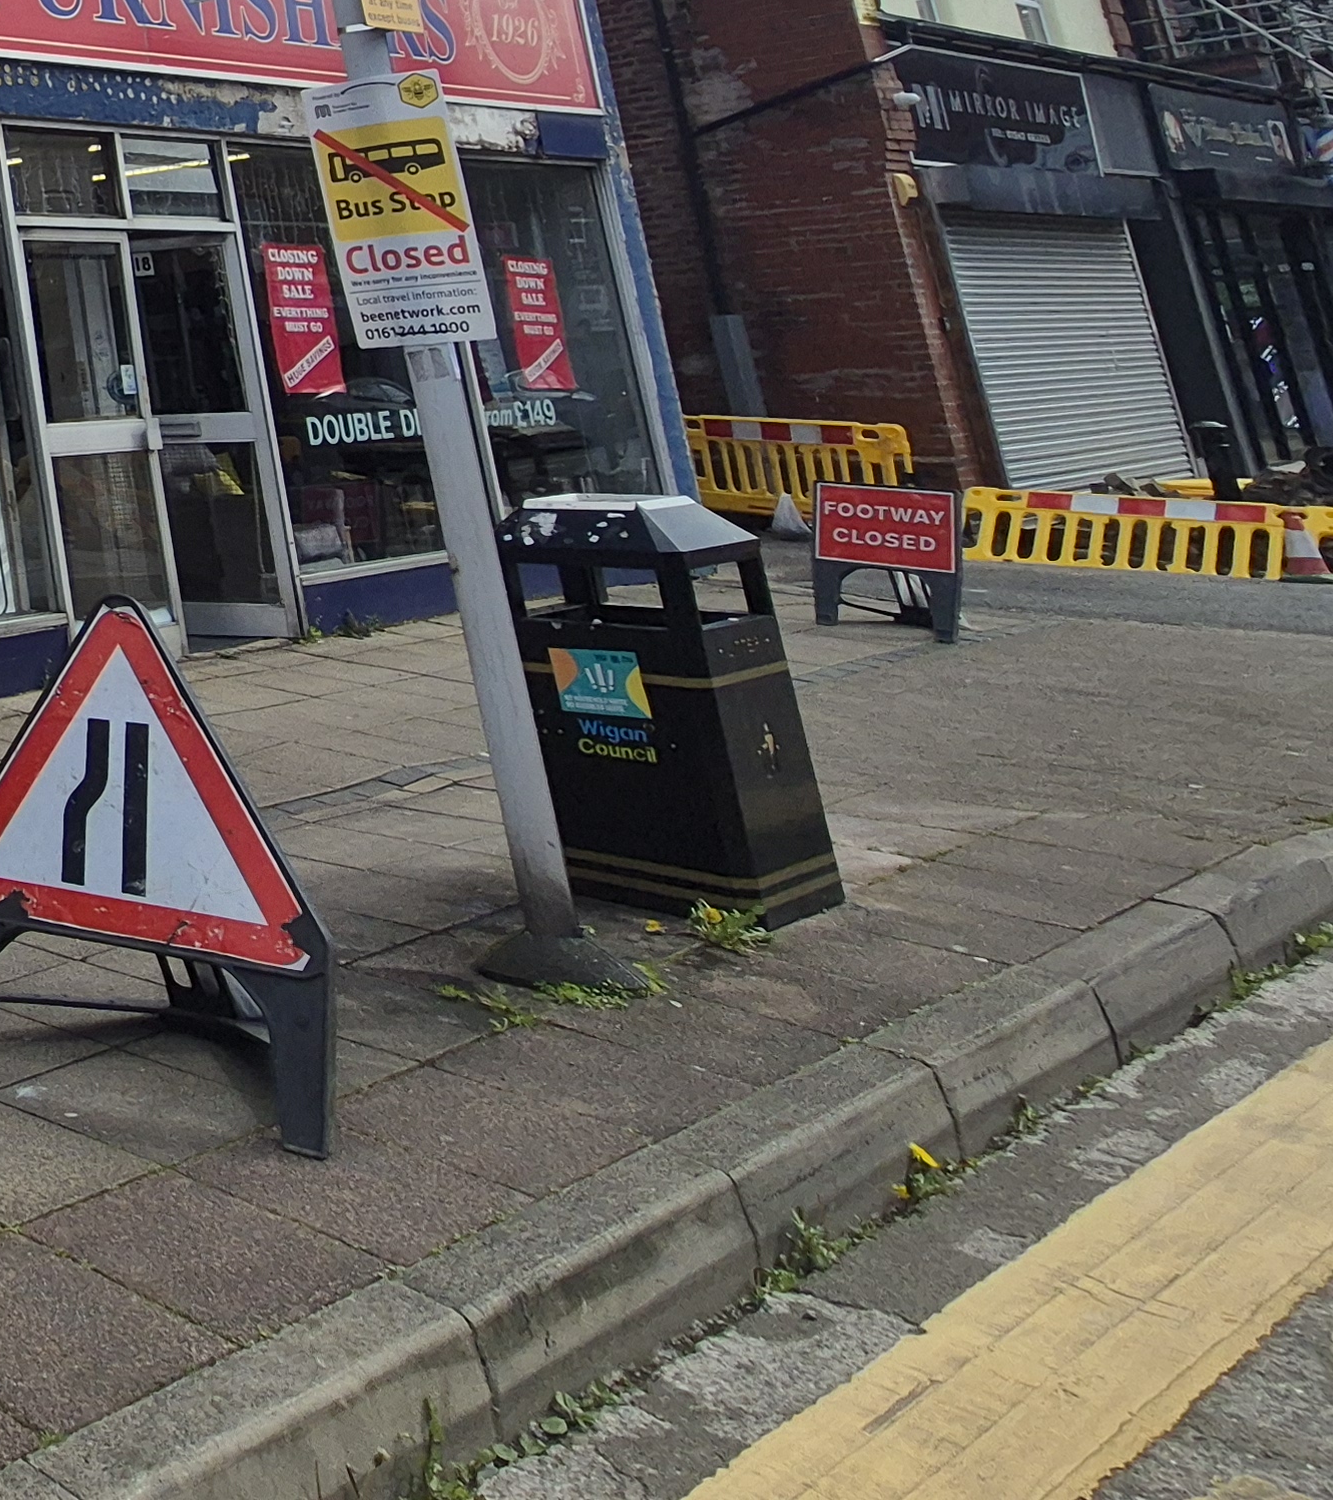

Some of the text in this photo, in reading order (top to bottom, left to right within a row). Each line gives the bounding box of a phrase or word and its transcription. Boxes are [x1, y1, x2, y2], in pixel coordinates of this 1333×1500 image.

[491, 14, 539, 46] 1926
[948, 89, 1081, 129] MIRROR IMAGE
[335, 199, 384, 220] Bus
[135, 256, 151, 271] 18
[268, 248, 318, 263] CLOSING
[345, 234, 470, 275] Closed
[277, 267, 313, 281] DOWN
[507, 260, 548, 275] CLOSING
[282, 285, 314, 299] SALE
[356, 294, 381, 306] Local
[382, 292, 411, 303] travel
[360, 304, 481, 323] beenetwork.com
[305, 410, 395, 446] DOUBLE
[483, 406, 512, 426] rom
[512, 399, 555, 429] £149
[823, 501, 945, 525] FOOTWAY
[833, 527, 936, 552] CLOSED
[577, 718, 648, 743] Wigan
[578, 738, 658, 763] Council
